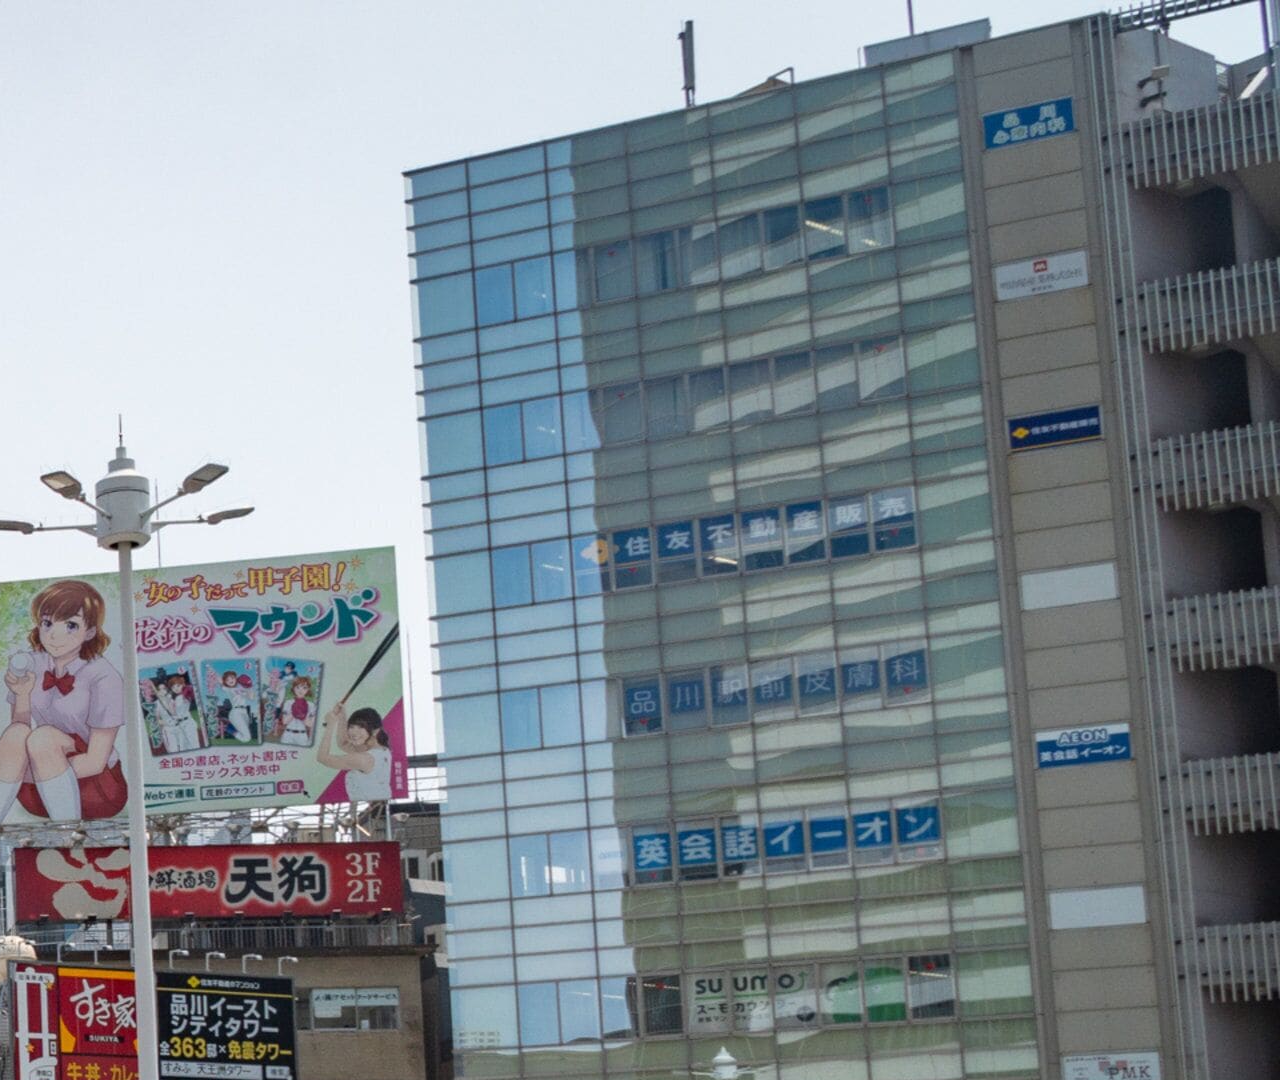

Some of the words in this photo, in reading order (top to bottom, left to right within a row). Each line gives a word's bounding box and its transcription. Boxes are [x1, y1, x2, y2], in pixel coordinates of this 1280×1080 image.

[624, 496, 908, 558] 住友不動産販売
[146, 561, 347, 608] 女の子だって甲子園!
[630, 656, 921, 714] 品川駅前皮膚科
[1056, 727, 1110, 745] AEON
[158, 750, 300, 770] 全国の書店、ネット書店で
[1080, 743, 1128, 759] イーオン
[180, 764, 282, 782] コミックス発売中
[636, 812, 934, 866] 英会話イーオン
[224, 854, 328, 905] 天狗
[345, 851, 382, 878] 3F
[346, 878, 383, 904] 2F
[69, 978, 139, 1034] すき家
[169, 993, 278, 1020] 品川イースト
[88, 1033, 121, 1044] SUKIYA
[169, 1015, 280, 1038] シティタワー
